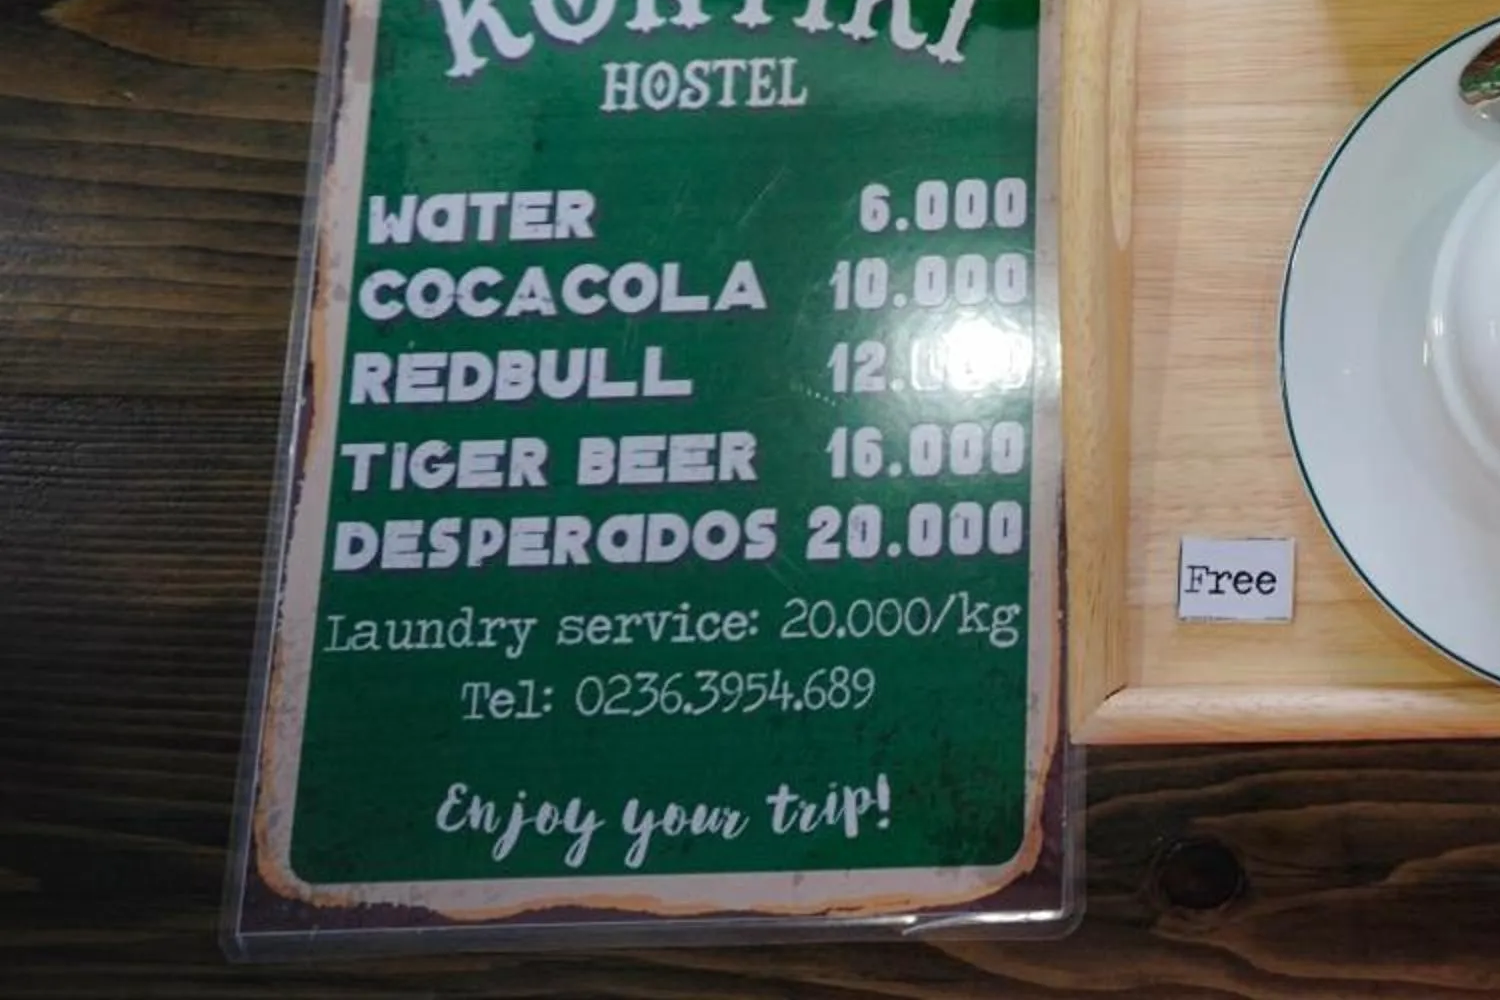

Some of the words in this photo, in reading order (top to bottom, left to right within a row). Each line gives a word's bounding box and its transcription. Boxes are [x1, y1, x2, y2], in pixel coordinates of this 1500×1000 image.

[600, 57, 808, 112] HOSTEL
[367, 189, 597, 244] WATER
[860, 177, 1028, 233] 6.000
[358, 260, 768, 321] COCACOLA
[829, 254, 1029, 311] 10.000
[349, 346, 693, 405] REDBULL
[340, 438, 548, 492] TIGER
[576, 430, 757, 486] BEER
[825, 421, 1026, 479] 16.000
[332, 508, 778, 572] DESPERADOS
[805, 500, 1024, 560] 20.000
[1183, 564, 1278, 596] Free
[323, 606, 539, 659] Laundry
[556, 601, 760, 645] service:
[780, 591, 1023, 649] 20.000/kg
[461, 680, 553, 720] Tel:
[575, 666, 876, 717] 0236.3954.689
[436, 783, 604, 868] Enjoy
[621, 798, 750, 869] your
[766, 773, 891, 839] trip!
